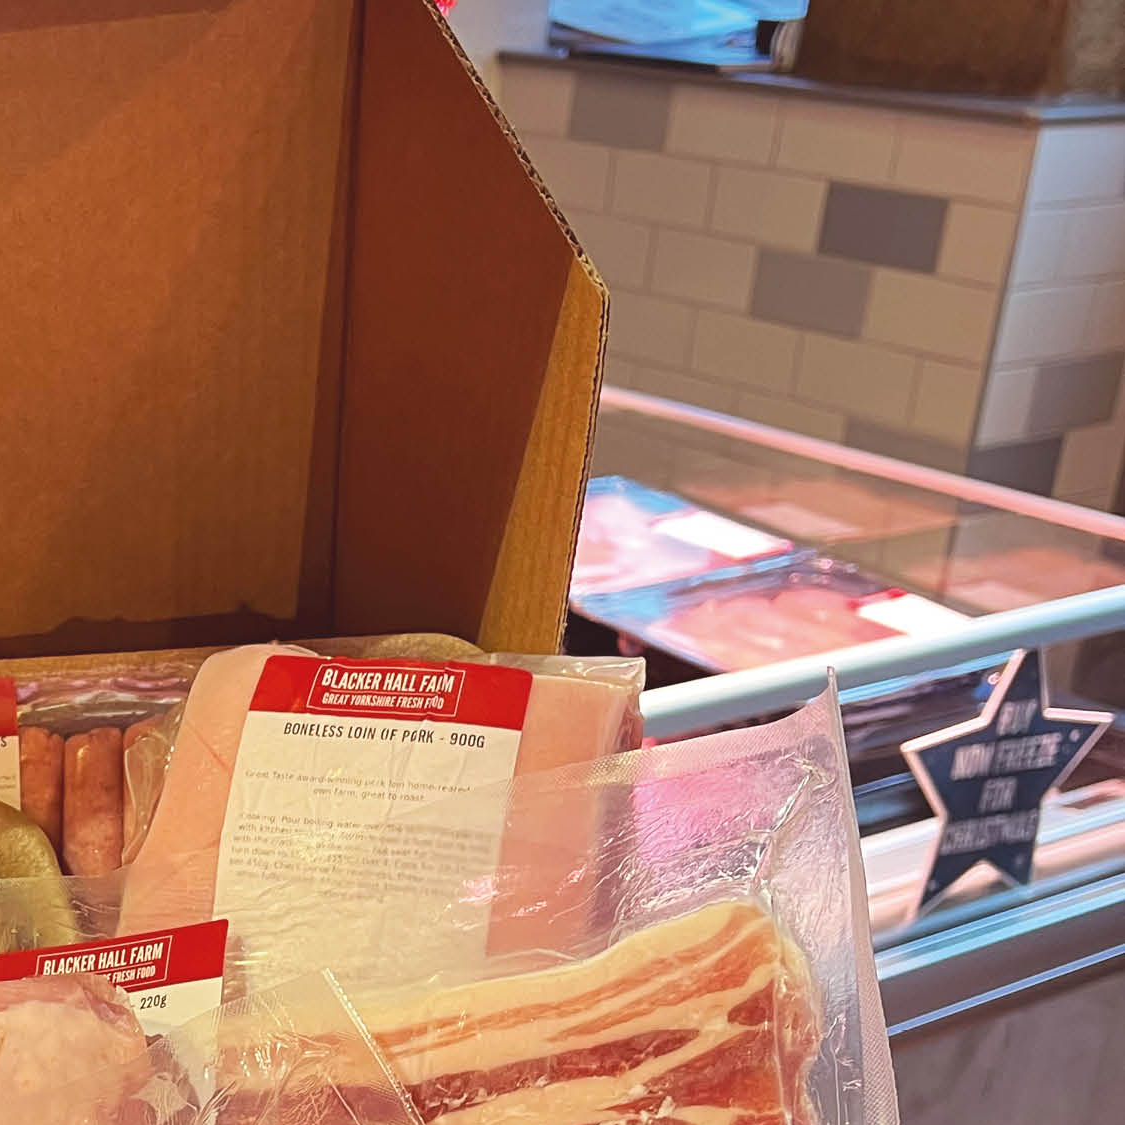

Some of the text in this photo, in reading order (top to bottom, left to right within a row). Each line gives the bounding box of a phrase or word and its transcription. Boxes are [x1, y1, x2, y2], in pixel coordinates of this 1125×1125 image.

[322, 669, 382, 690] BLACKER
[383, 673, 416, 692] HALL
[322, 692, 349, 705] GREAT
[350, 694, 395, 707] YORKSHIRE
[396, 696, 423, 708] FRESH
[284, 722, 343, 738] BONELESS
[348, 726, 376, 740] LOIN
[402, 730, 434, 744] PORK
[449, 733, 485, 748] 900G
[43, 943, 164, 976] BLACKER HALL FARM
[112, 965, 155, 982] FRESH FOOD
[140, 995, 167, 1010] 220g
